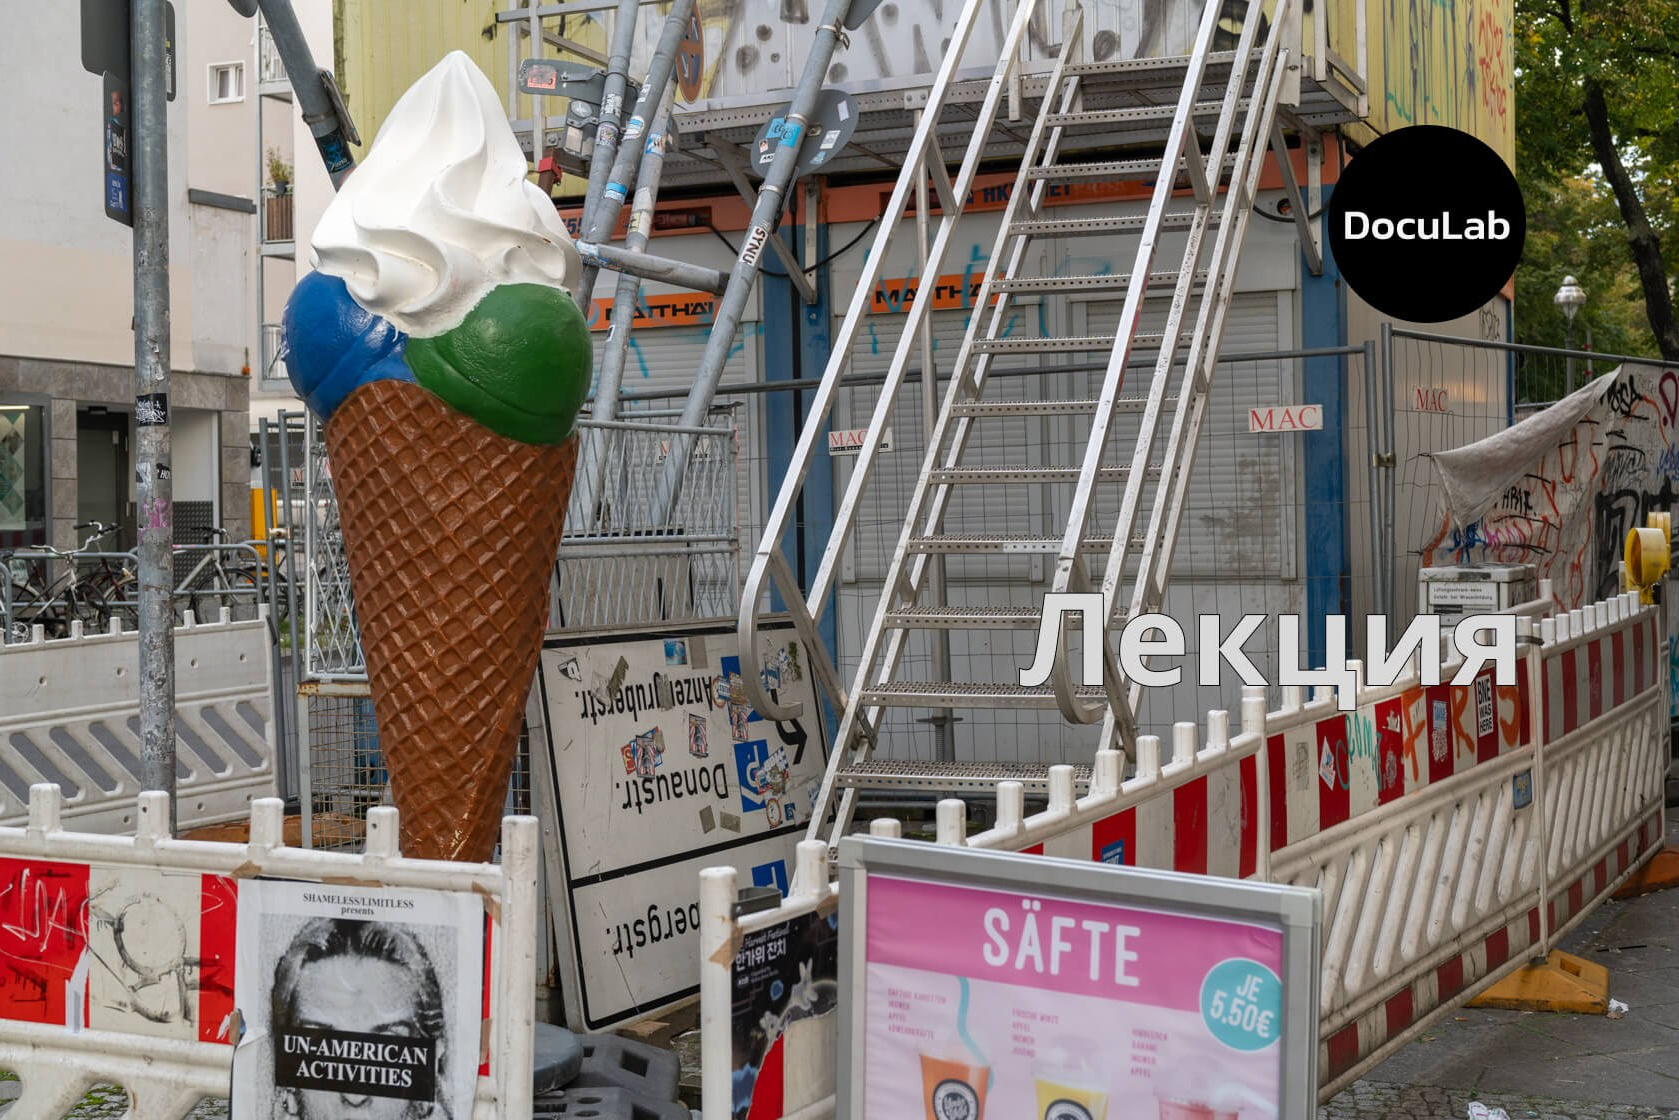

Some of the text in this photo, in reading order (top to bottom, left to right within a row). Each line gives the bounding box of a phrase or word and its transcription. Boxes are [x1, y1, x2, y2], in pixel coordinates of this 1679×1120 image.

[1415, 388, 1448, 412] MAC
[1250, 406, 1318, 432] MAC
[1477, 677, 1491, 705] BNE
[1478, 717, 1494, 733] HERE
[1479, 704, 1492, 718] WAS
[615, 762, 729, 815] Donaustr.
[302, 892, 415, 909] SHAMELESS/LIMITLESS
[340, 906, 375, 916] presents
[982, 898, 1142, 988] SÄFTE
[1235, 973, 1264, 1004] JE
[1209, 989, 1276, 1039] 5.50€
[282, 1034, 429, 1066] UN-AMERICAN
[295, 1058, 413, 1088] ACTIVITIES
